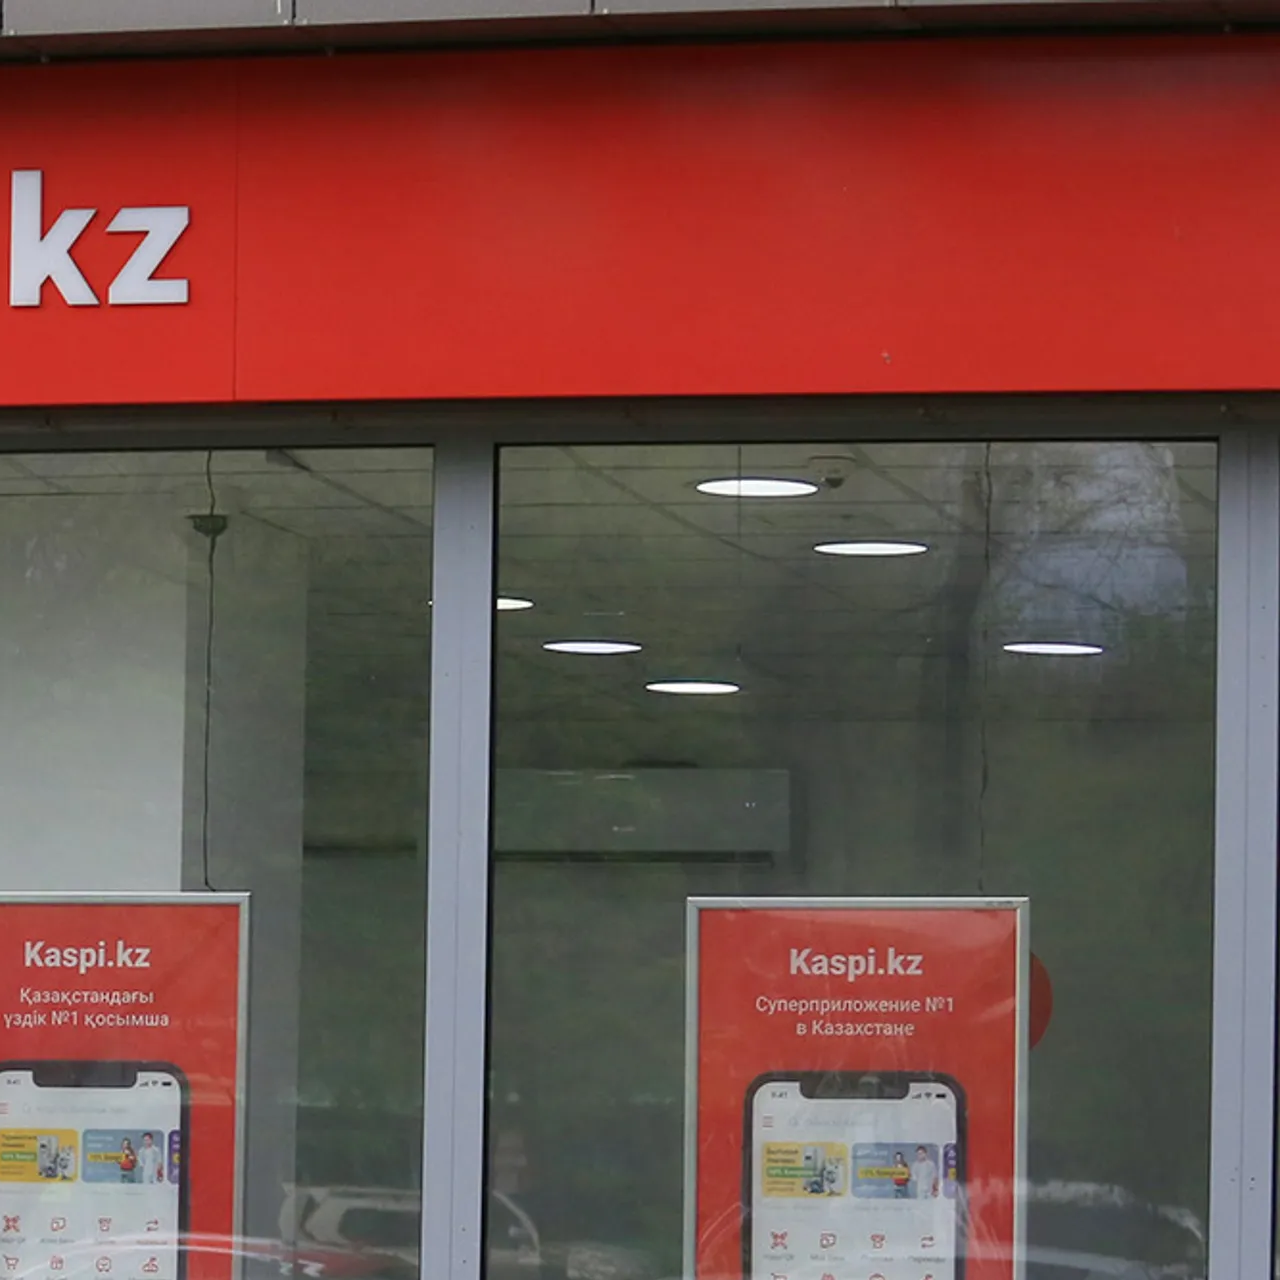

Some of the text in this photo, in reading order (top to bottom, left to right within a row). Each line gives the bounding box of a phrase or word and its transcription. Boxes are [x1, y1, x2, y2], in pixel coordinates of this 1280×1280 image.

[24, 940, 151, 974] Kaspi.kz
[789, 947, 923, 982] Kaspi.kz
[20, 987, 154, 1006] Қазақстандағы
[755, 995, 954, 1015] Суперприложение №1
[3, 1010, 170, 1029] үздік №1 қосымша
[796, 1020, 915, 1036] в Казахстане
